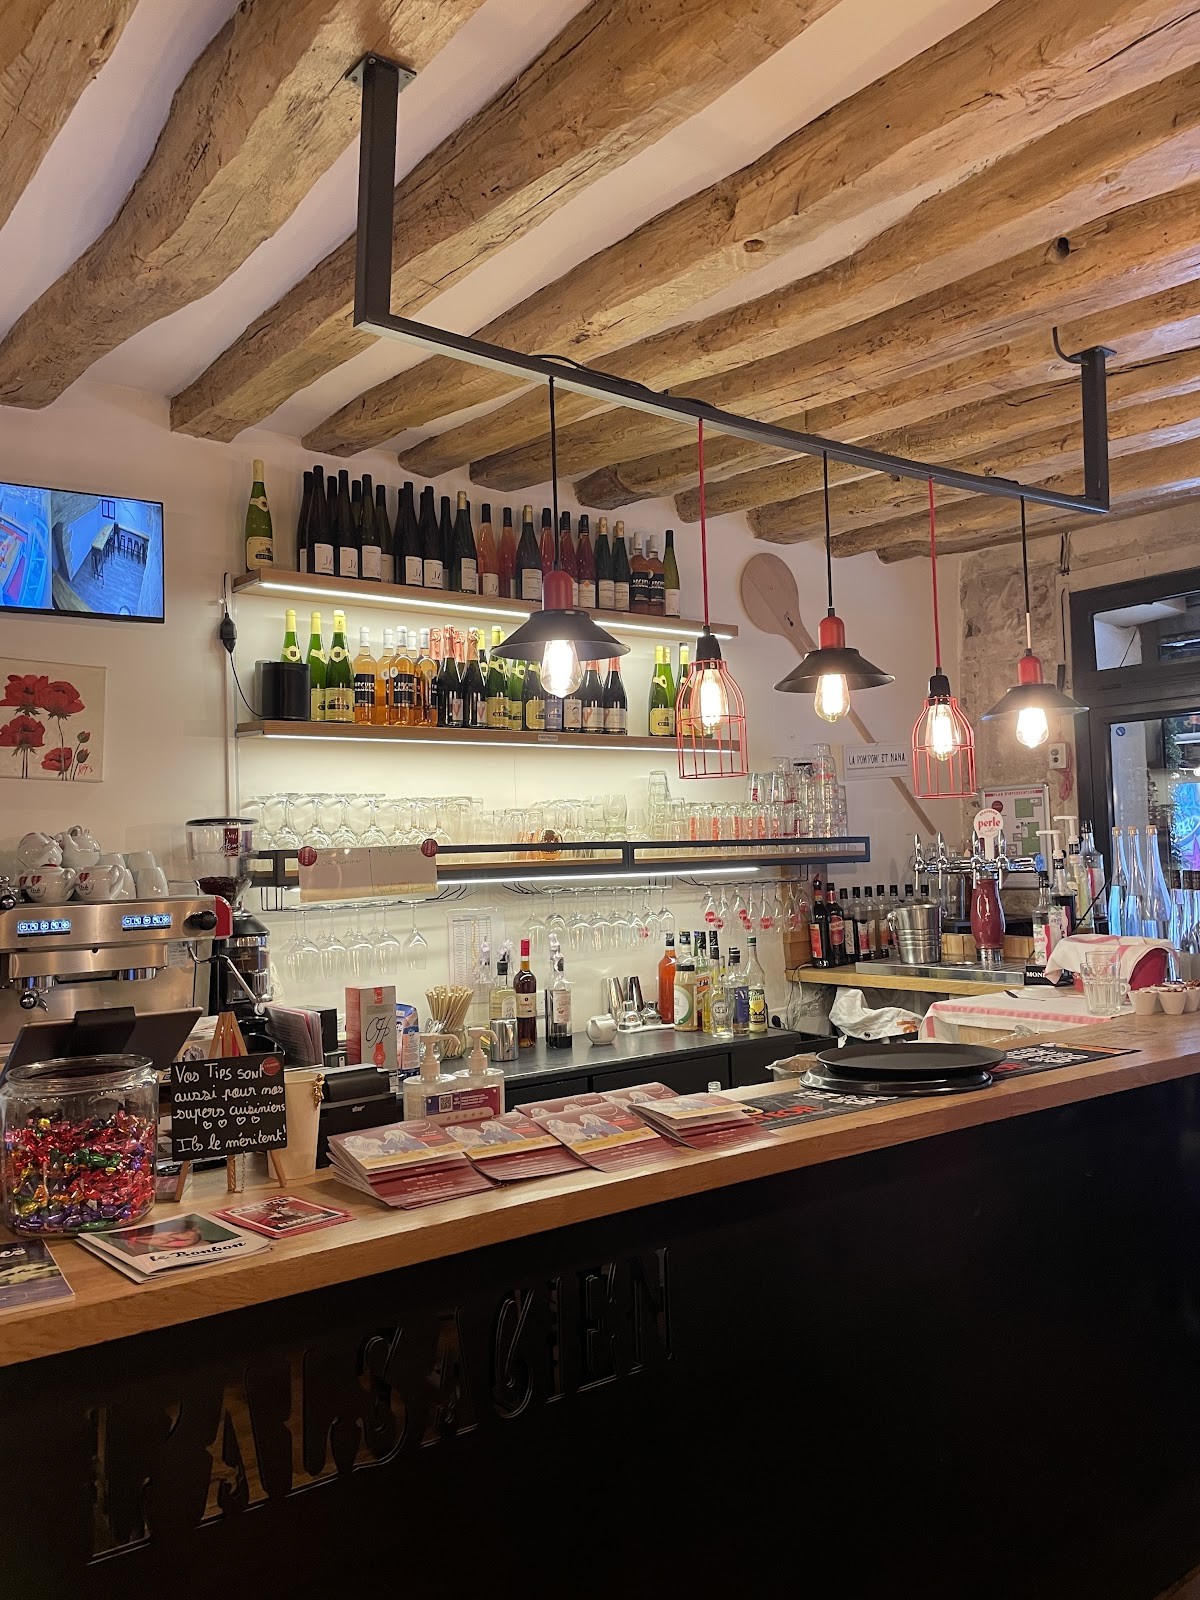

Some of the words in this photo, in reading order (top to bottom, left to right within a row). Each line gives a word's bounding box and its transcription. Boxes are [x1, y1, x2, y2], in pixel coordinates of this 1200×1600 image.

[848, 755, 856, 765] LA
[881, 753, 889, 763] ET
[978, 816, 1001, 831] perle
[175, 1065, 200, 1083] Vos
[174, 1084, 217, 1103] aussi
[221, 1086, 257, 1102] pour
[261, 1085, 284, 1096] nos
[172, 1106, 226, 1125] supers
[229, 1100, 286, 1116] cuisiniers
[176, 1135, 204, 1153] Ils
[207, 1133, 222, 1151] le
[169, 1242, 247, 1259] Bonbon
[85, 1244, 675, 1567] L'ALSACIEN
